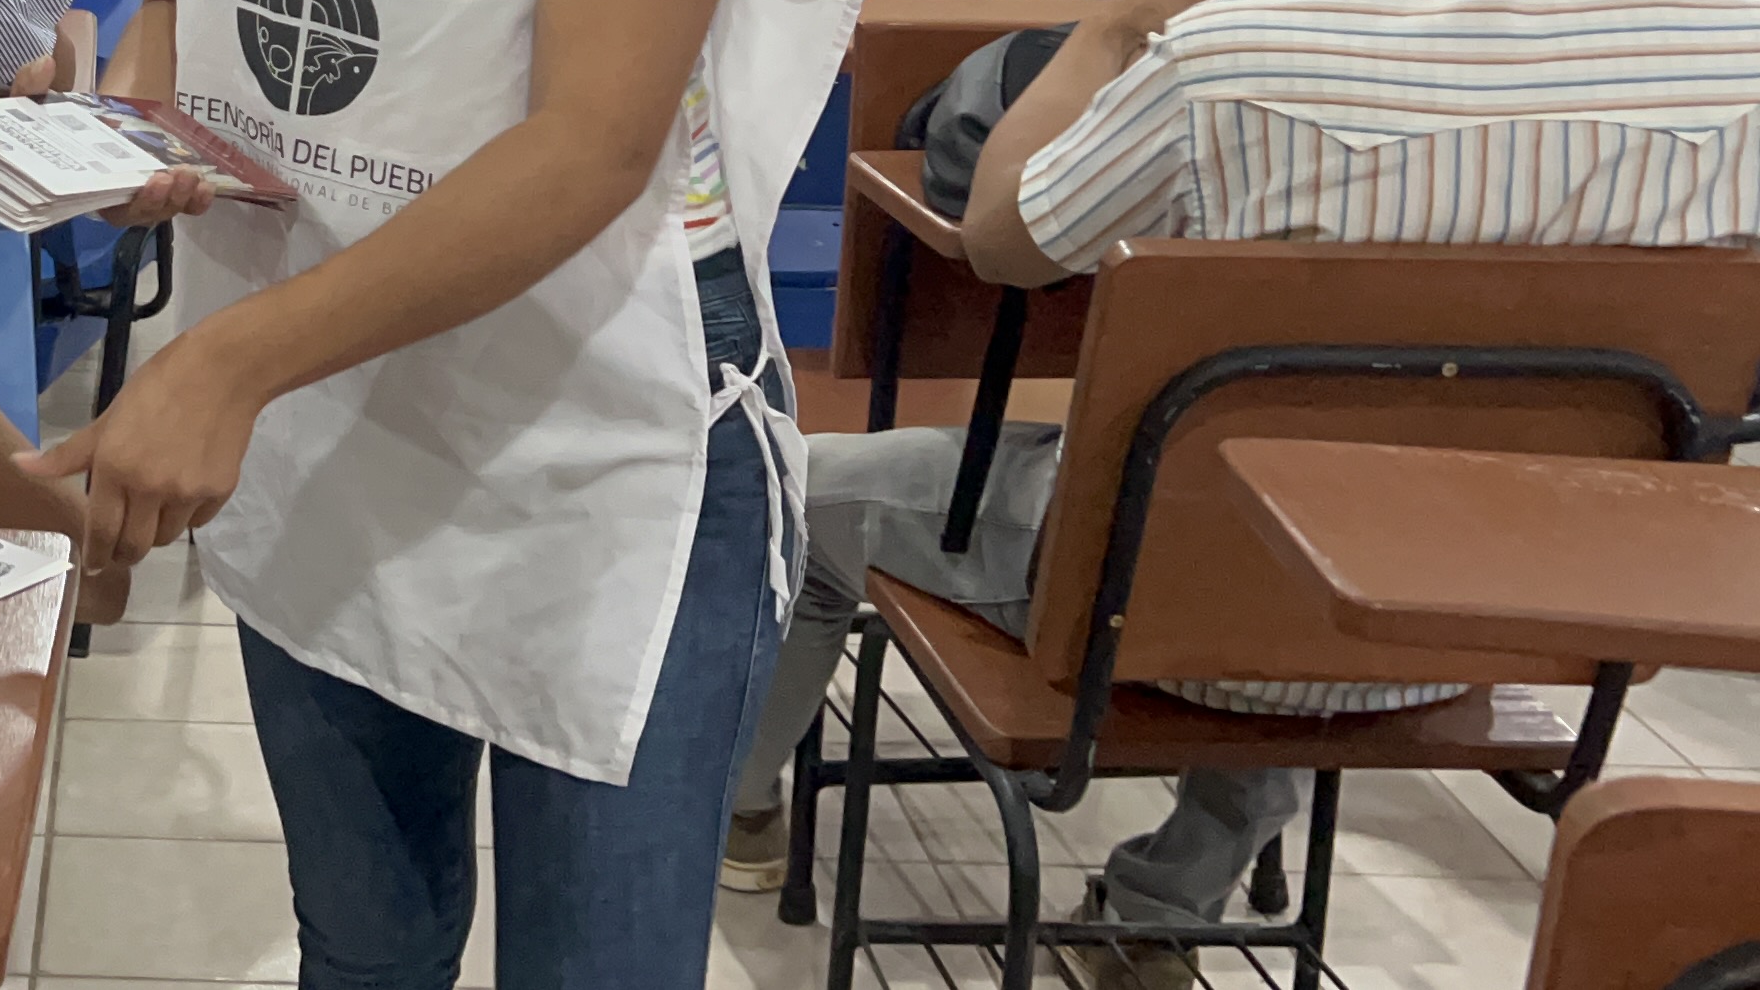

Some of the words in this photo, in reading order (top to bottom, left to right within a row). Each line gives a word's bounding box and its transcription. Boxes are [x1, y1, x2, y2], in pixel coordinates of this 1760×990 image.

[292, 138, 342, 175] DEL
[349, 154, 434, 194] PUEB
[348, 193, 370, 211] DE
